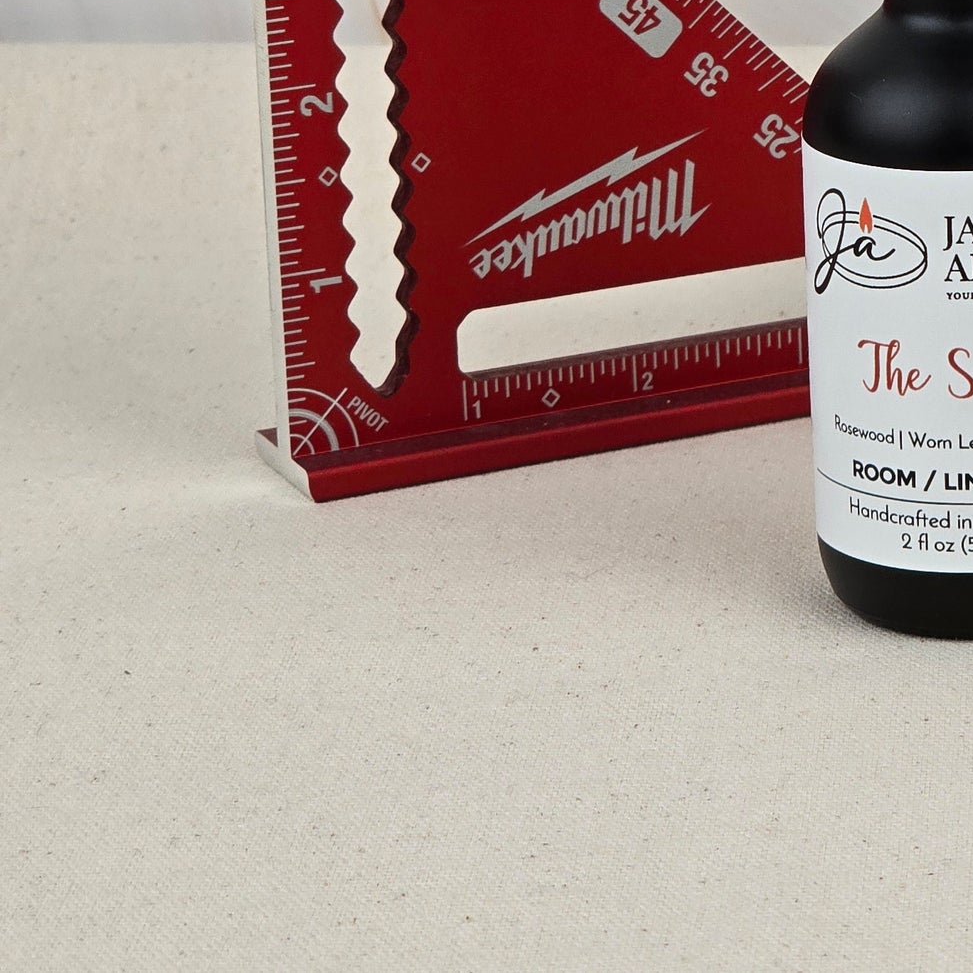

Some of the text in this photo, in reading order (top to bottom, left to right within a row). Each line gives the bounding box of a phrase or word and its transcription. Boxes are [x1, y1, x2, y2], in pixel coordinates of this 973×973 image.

[684, 50, 730, 98] 35
[300, 92, 334, 117] 2
[753, 113, 800, 159] 25
[469, 159, 713, 279] Milwaukee
[310, 275, 343, 294] 1
[642, 372, 654, 391] 2
[857, 339, 933, 397] The
[347, 395, 389, 433] PIVOT
[472, 400, 481, 419] 1
[834, 414, 895, 445] Rosewood
[908, 431, 952, 450] Worn
[852, 458, 917, 489] ROOM
[849, 496, 951, 529] Handcrafted
[957, 513, 973, 530] in
[901, 533, 912, 550] 2
[918, 532, 929, 552] fl
[934, 538, 955, 553] oz
